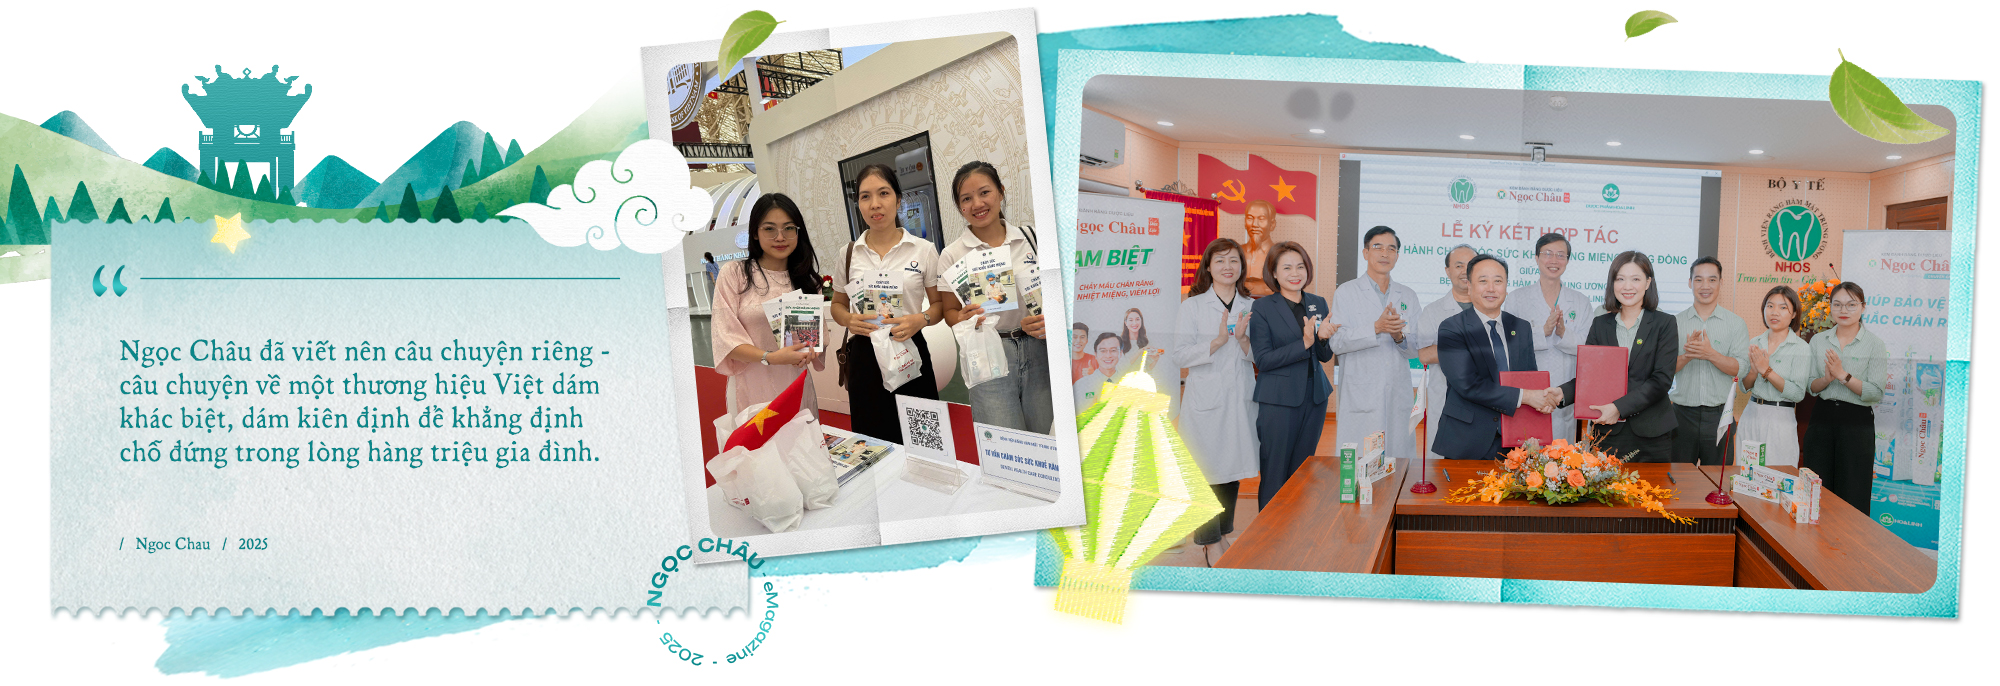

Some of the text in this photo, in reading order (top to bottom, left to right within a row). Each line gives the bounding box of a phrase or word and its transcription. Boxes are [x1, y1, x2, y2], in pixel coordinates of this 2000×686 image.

[1767, 177, 1826, 191] BỘ Y TẾ
[1509, 191, 1562, 203] Ngọc Châu
[1766, 201, 1785, 219] RĂNG
[1804, 201, 1819, 213] MẶT
[1108, 221, 1146, 235] Châu
[1442, 219, 1463, 238] LỄ
[1469, 221, 1493, 239] KÝ
[1499, 222, 1535, 241] KẾT
[1583, 225, 1619, 243] TÁC
[1761, 219, 1769, 238] VIỆN
[1818, 212, 1829, 239] TRUNG
[1403, 243, 1434, 255] HÀNH
[1497, 247, 1519, 259] SỨC
[1761, 239, 1775, 259] BỆNH
[1812, 240, 1828, 260] ƯƠNG
[1106, 245, 1154, 271] BIỆT
[1880, 258, 1916, 273] Ngọc
[1775, 261, 1810, 273] NHOS
[1098, 281, 1116, 290] MÁU
[1116, 280, 1135, 289] CHÂN
[1135, 279, 1154, 288] RĂNG
[1737, 272, 1758, 283] Trao
[1759, 273, 1779, 284] niềm
[1781, 275, 1793, 284] tin
[1076, 287, 1160, 302] NHIỆT MIỆNG, VIÊM LỢI
[1866, 293, 1947, 312] IÚP BẢO VỆ
[1860, 310, 1949, 328] HẮC CHÂN R
